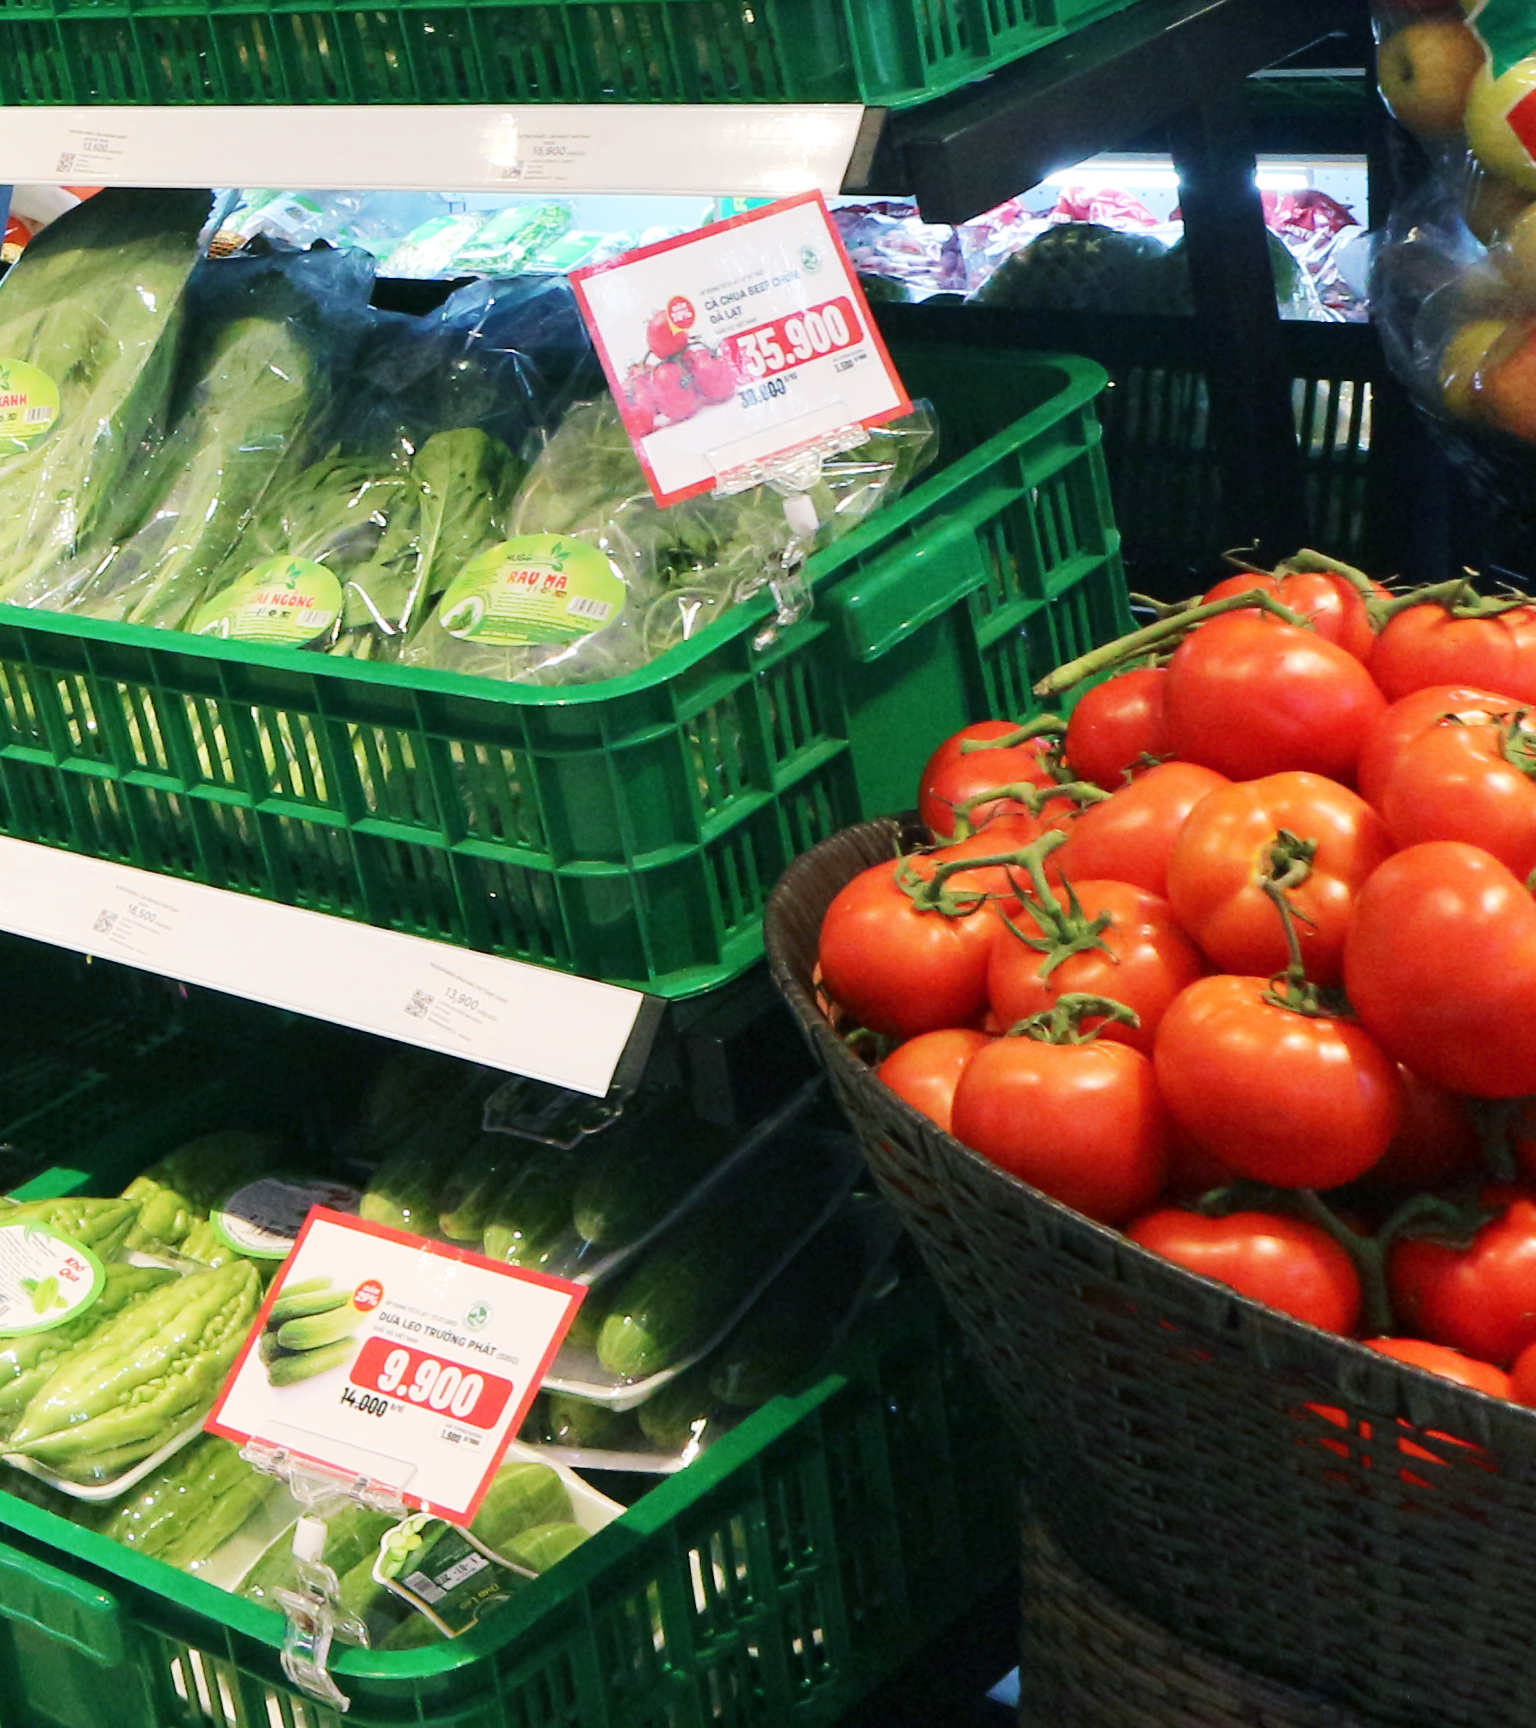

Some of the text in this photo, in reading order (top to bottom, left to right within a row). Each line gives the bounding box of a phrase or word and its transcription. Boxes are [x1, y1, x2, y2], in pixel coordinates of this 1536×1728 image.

[736, 304, 850, 378] 35.900
[402, 1319, 422, 1334] LEO
[467, 1339, 497, 1357] PHÁT
[340, 1386, 389, 1418] 14.000
[377, 1348, 485, 1419] 9.900
